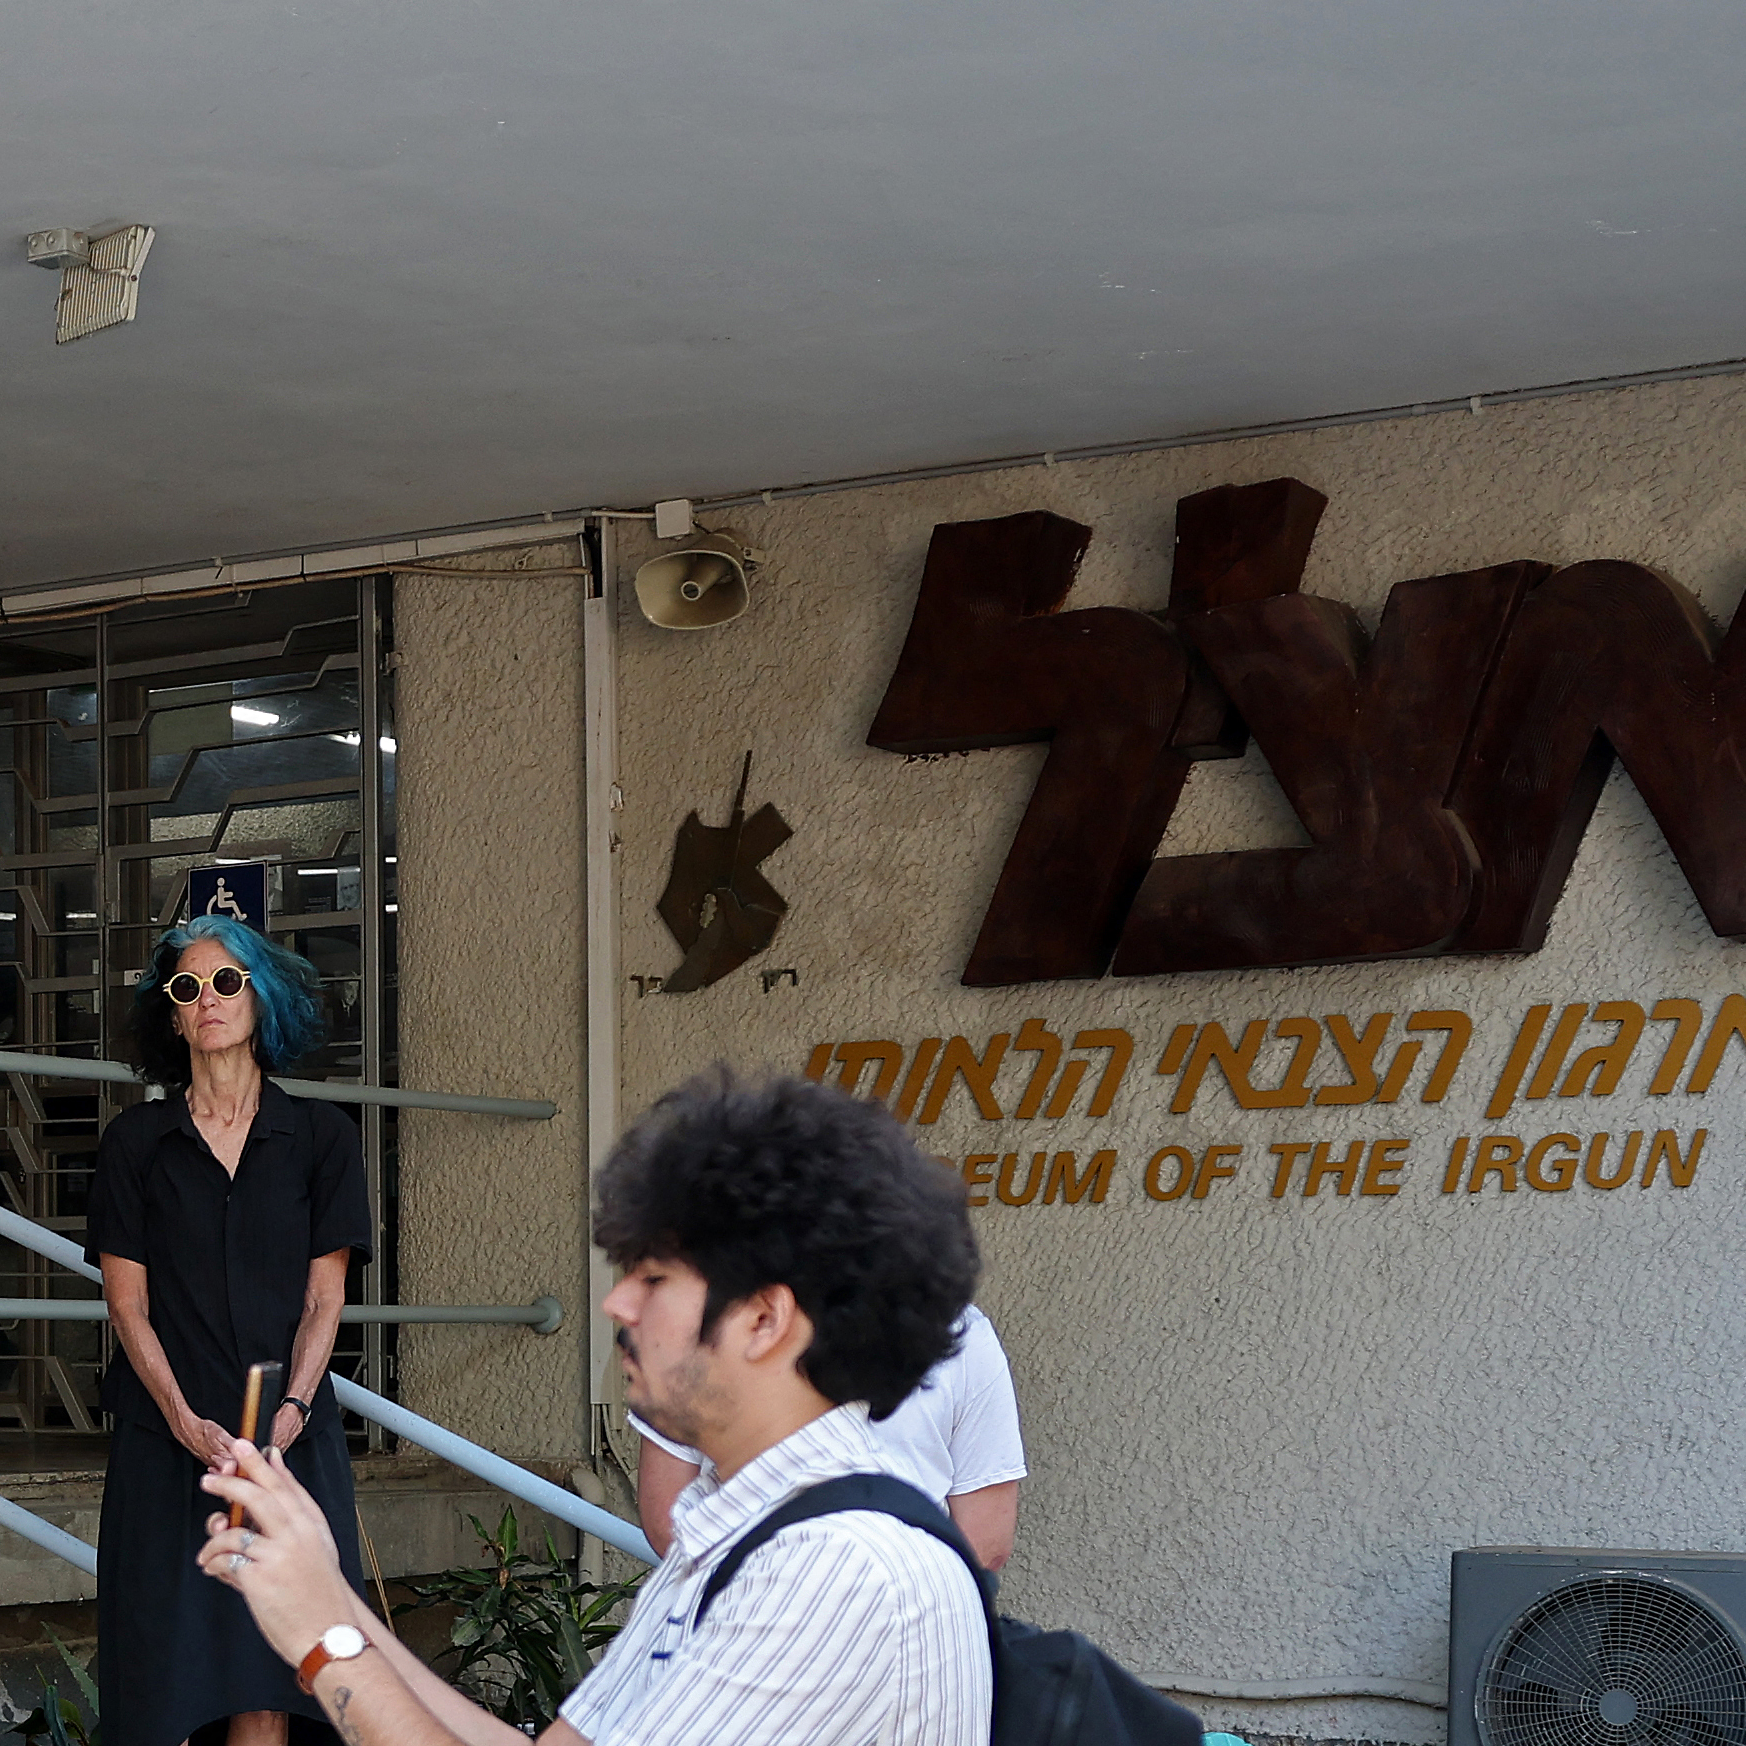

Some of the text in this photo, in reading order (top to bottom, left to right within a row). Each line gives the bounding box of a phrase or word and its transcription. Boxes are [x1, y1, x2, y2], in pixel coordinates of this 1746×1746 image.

[1157, 1009, 1473, 1114] הצבאי
[931, 1128, 1709, 1206] EUM OF THE IRGUN
